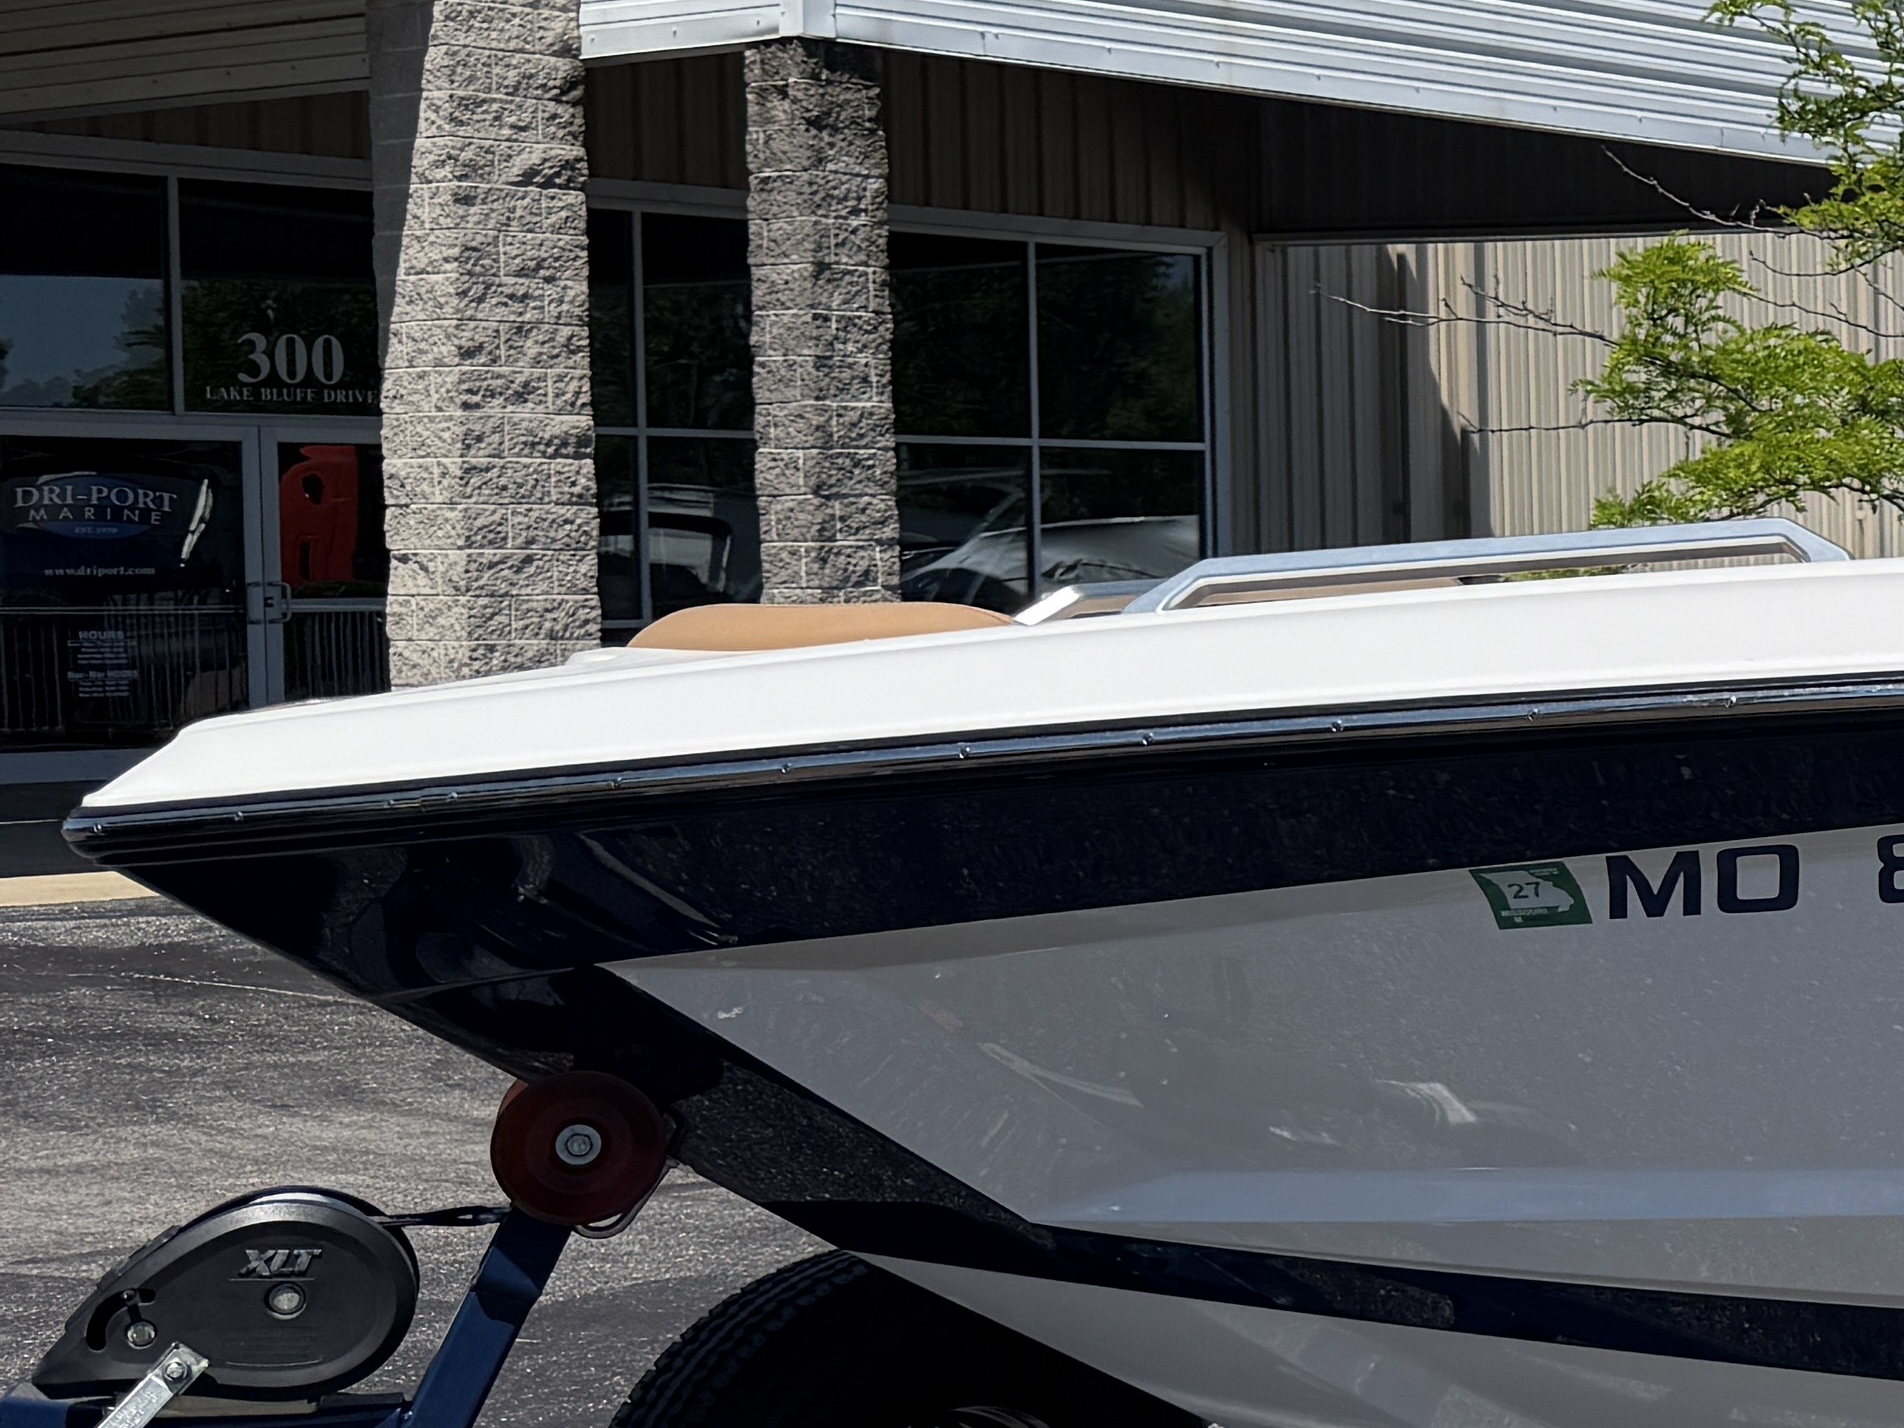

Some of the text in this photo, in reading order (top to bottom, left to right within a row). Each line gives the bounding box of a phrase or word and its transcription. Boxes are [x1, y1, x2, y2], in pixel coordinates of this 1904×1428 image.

[237, 332, 344, 384] 300
[205, 385, 378, 403] LAKE BLUFF DRIVE
[14, 485, 177, 512] DRI-PORT
[29, 507, 162, 525] MARINE
[44, 565, 155, 576] www.driport.com
[1508, 881, 1540, 899] 27
[1605, 843, 1800, 920] MO
[240, 1249, 322, 1276] XLT
